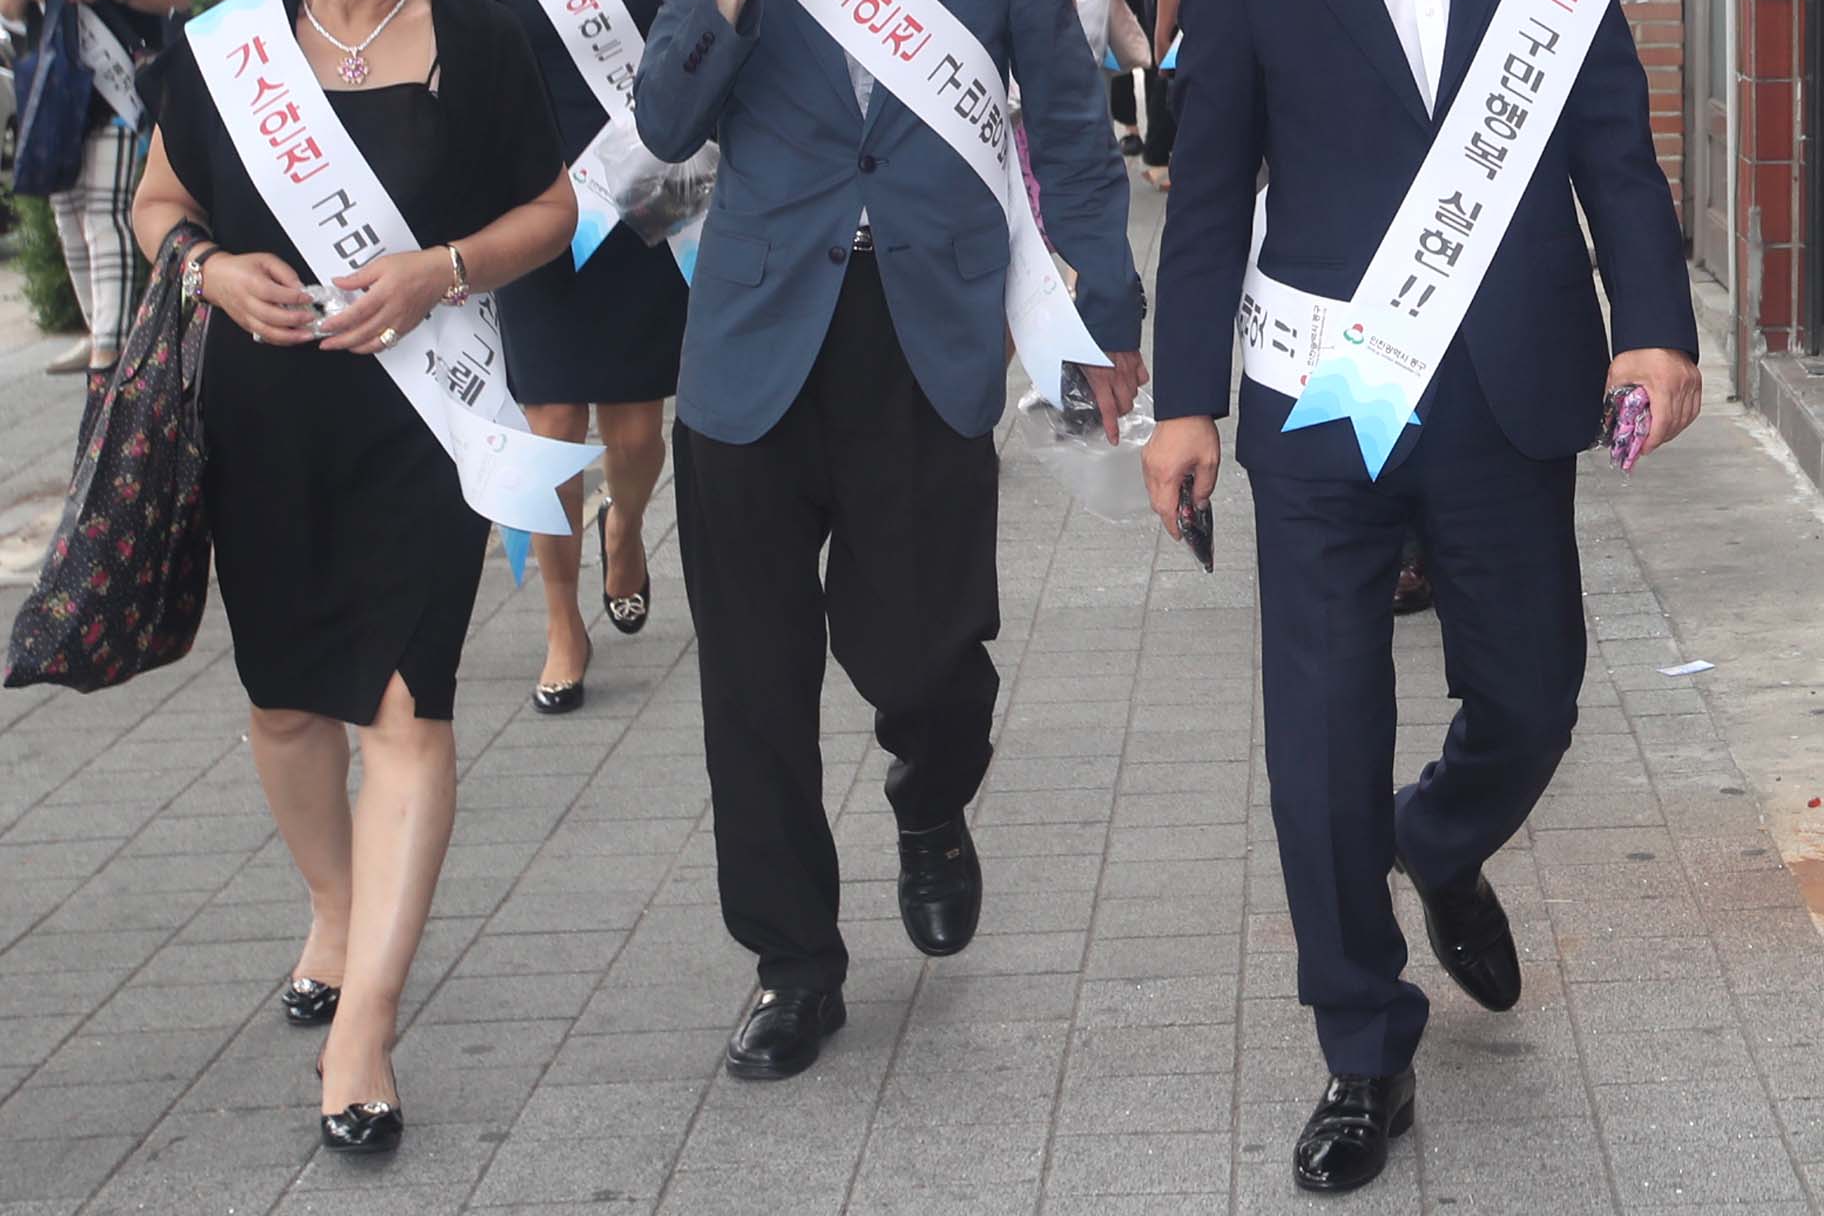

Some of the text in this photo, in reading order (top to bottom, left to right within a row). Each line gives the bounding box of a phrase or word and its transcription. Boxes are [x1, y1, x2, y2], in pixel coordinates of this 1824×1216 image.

[226, 34, 388, 271] 가스안전 구민
[1464, 17, 1561, 182] 구민행복
